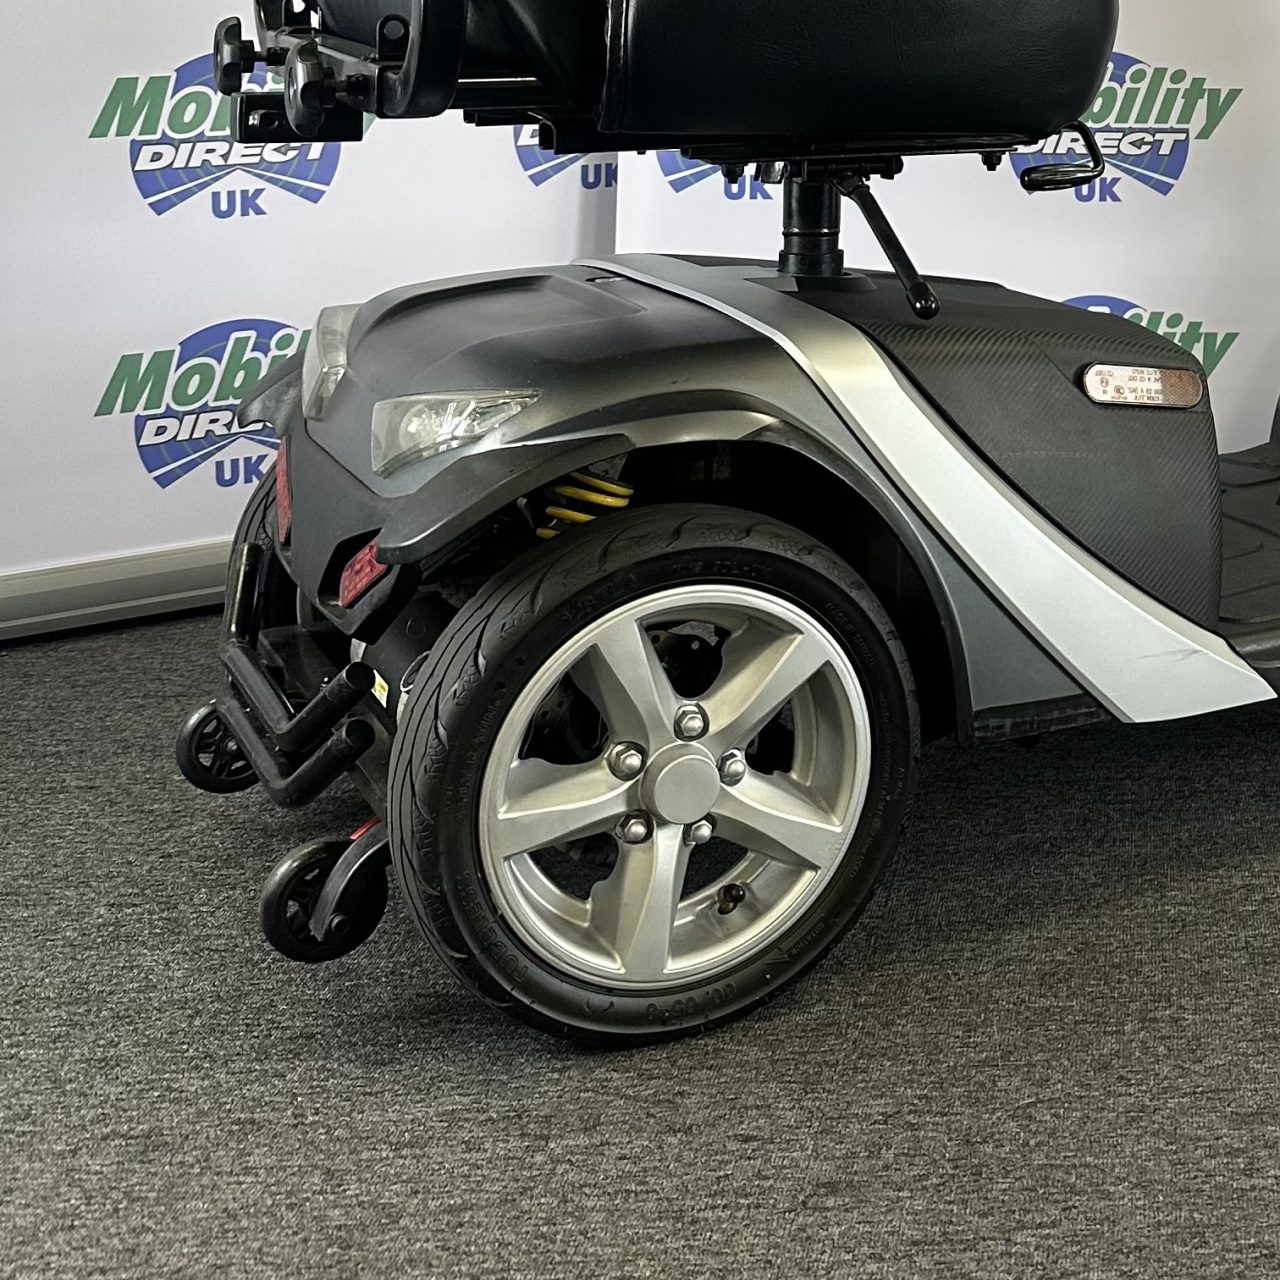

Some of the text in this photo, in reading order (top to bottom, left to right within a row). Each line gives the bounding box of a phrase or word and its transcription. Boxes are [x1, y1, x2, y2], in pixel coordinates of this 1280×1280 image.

[1078, 67, 1244, 140] bility
[211, 188, 267, 219] UK
[139, 410, 274, 446] DIR
[216, 454, 270, 488] UK
